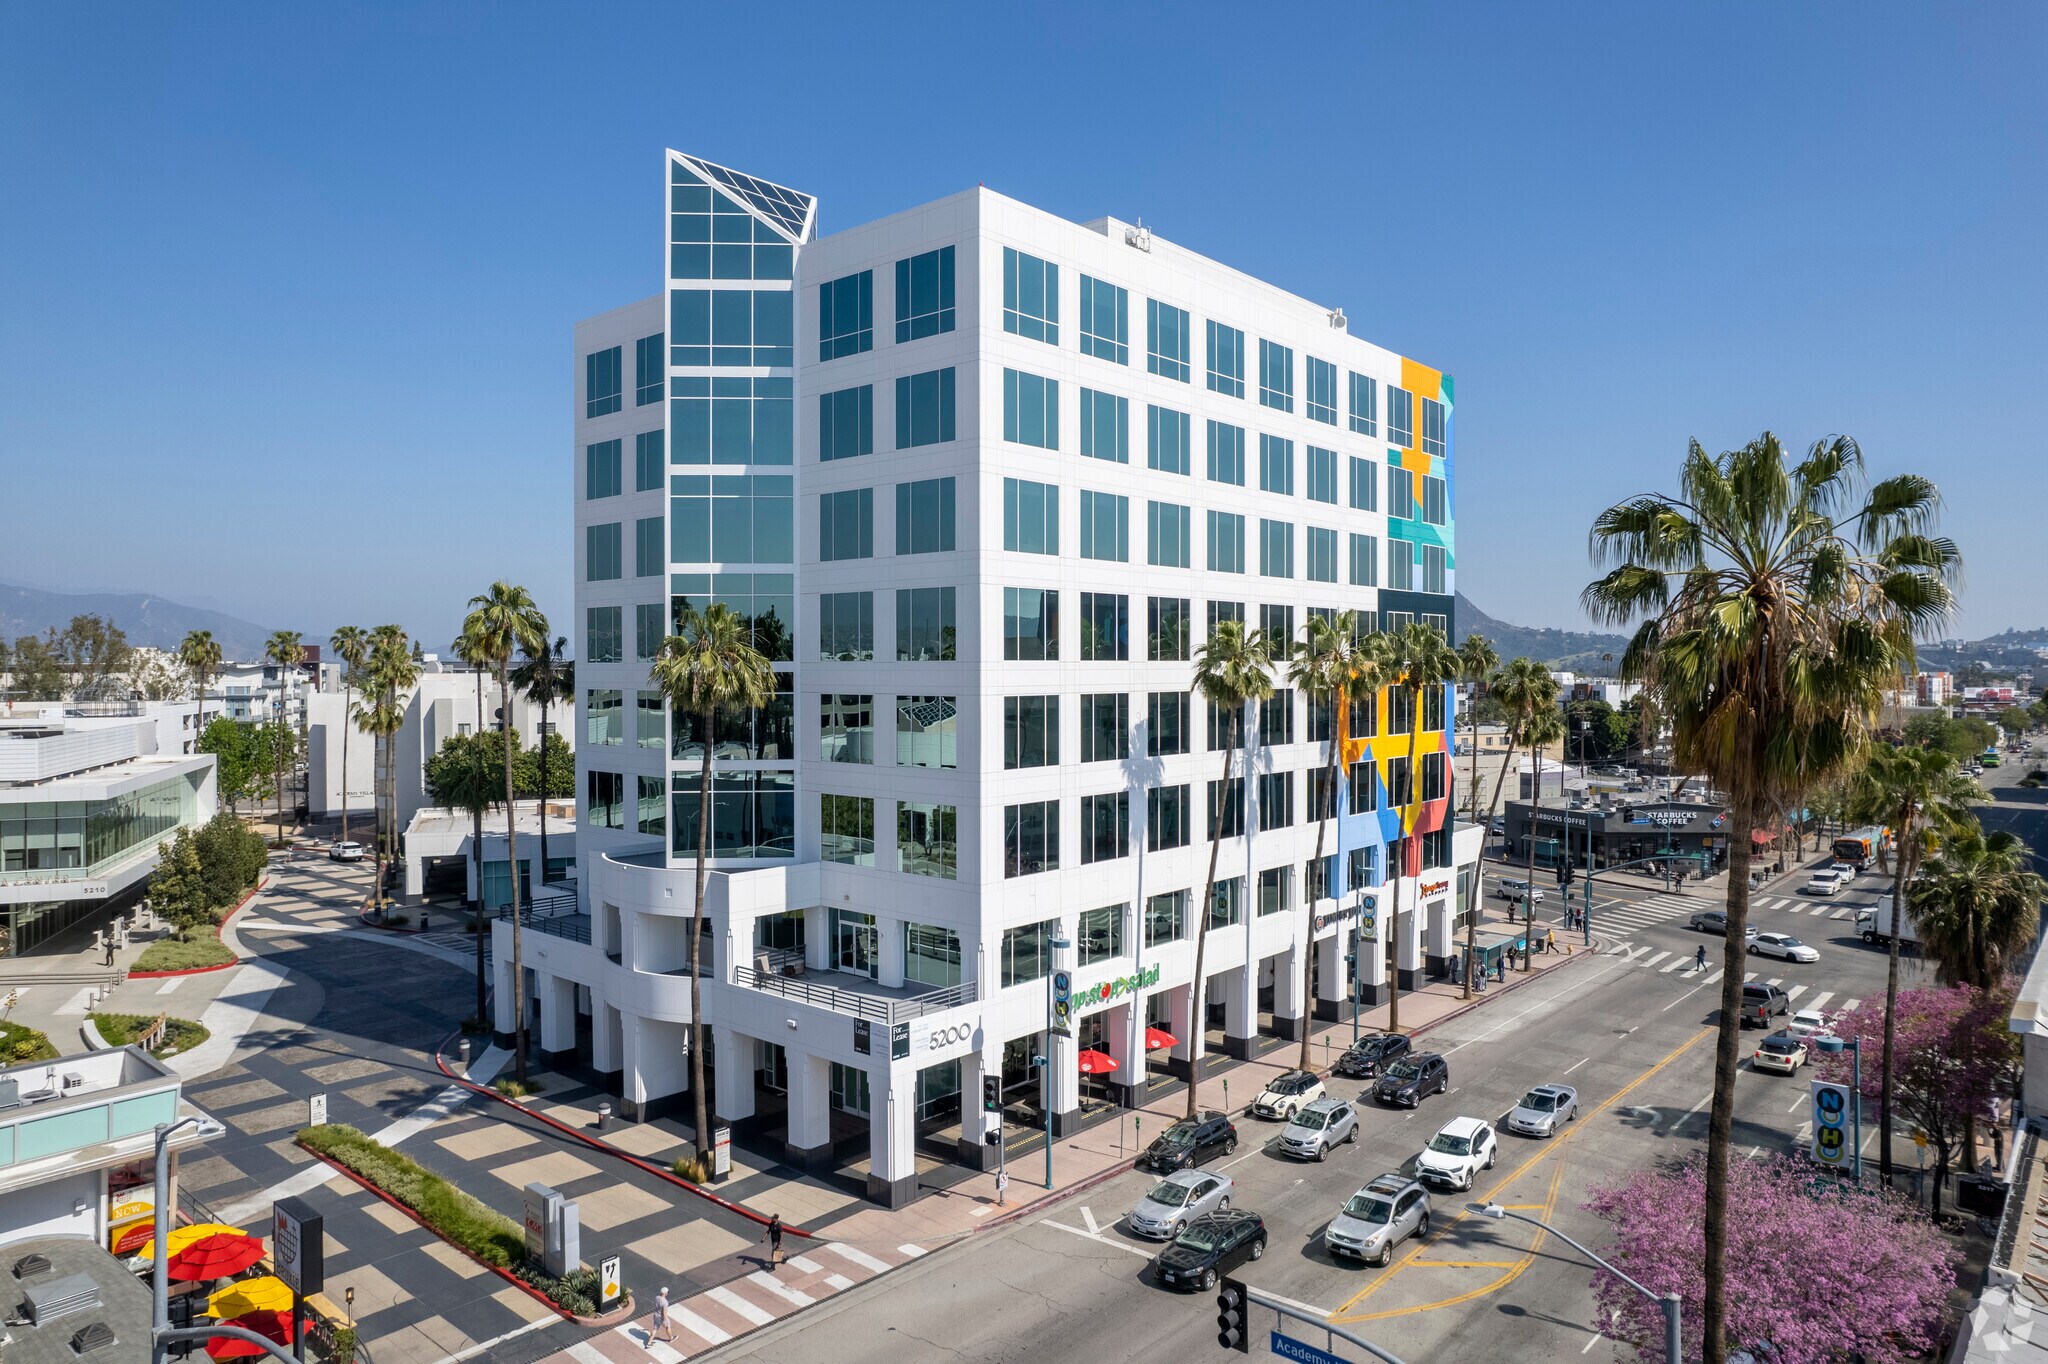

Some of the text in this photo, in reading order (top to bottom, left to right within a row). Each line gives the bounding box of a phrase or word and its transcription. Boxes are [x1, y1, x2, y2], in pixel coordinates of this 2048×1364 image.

[1563, 816, 1586, 825] COFFEE
[1129, 963, 1159, 990] salad
[855, 1019, 863, 1028] For
[855, 1027, 869, 1037] Lease
[892, 1026, 902, 1035] For
[893, 1032, 908, 1042] Lease
[929, 1022, 971, 1051] 5200
